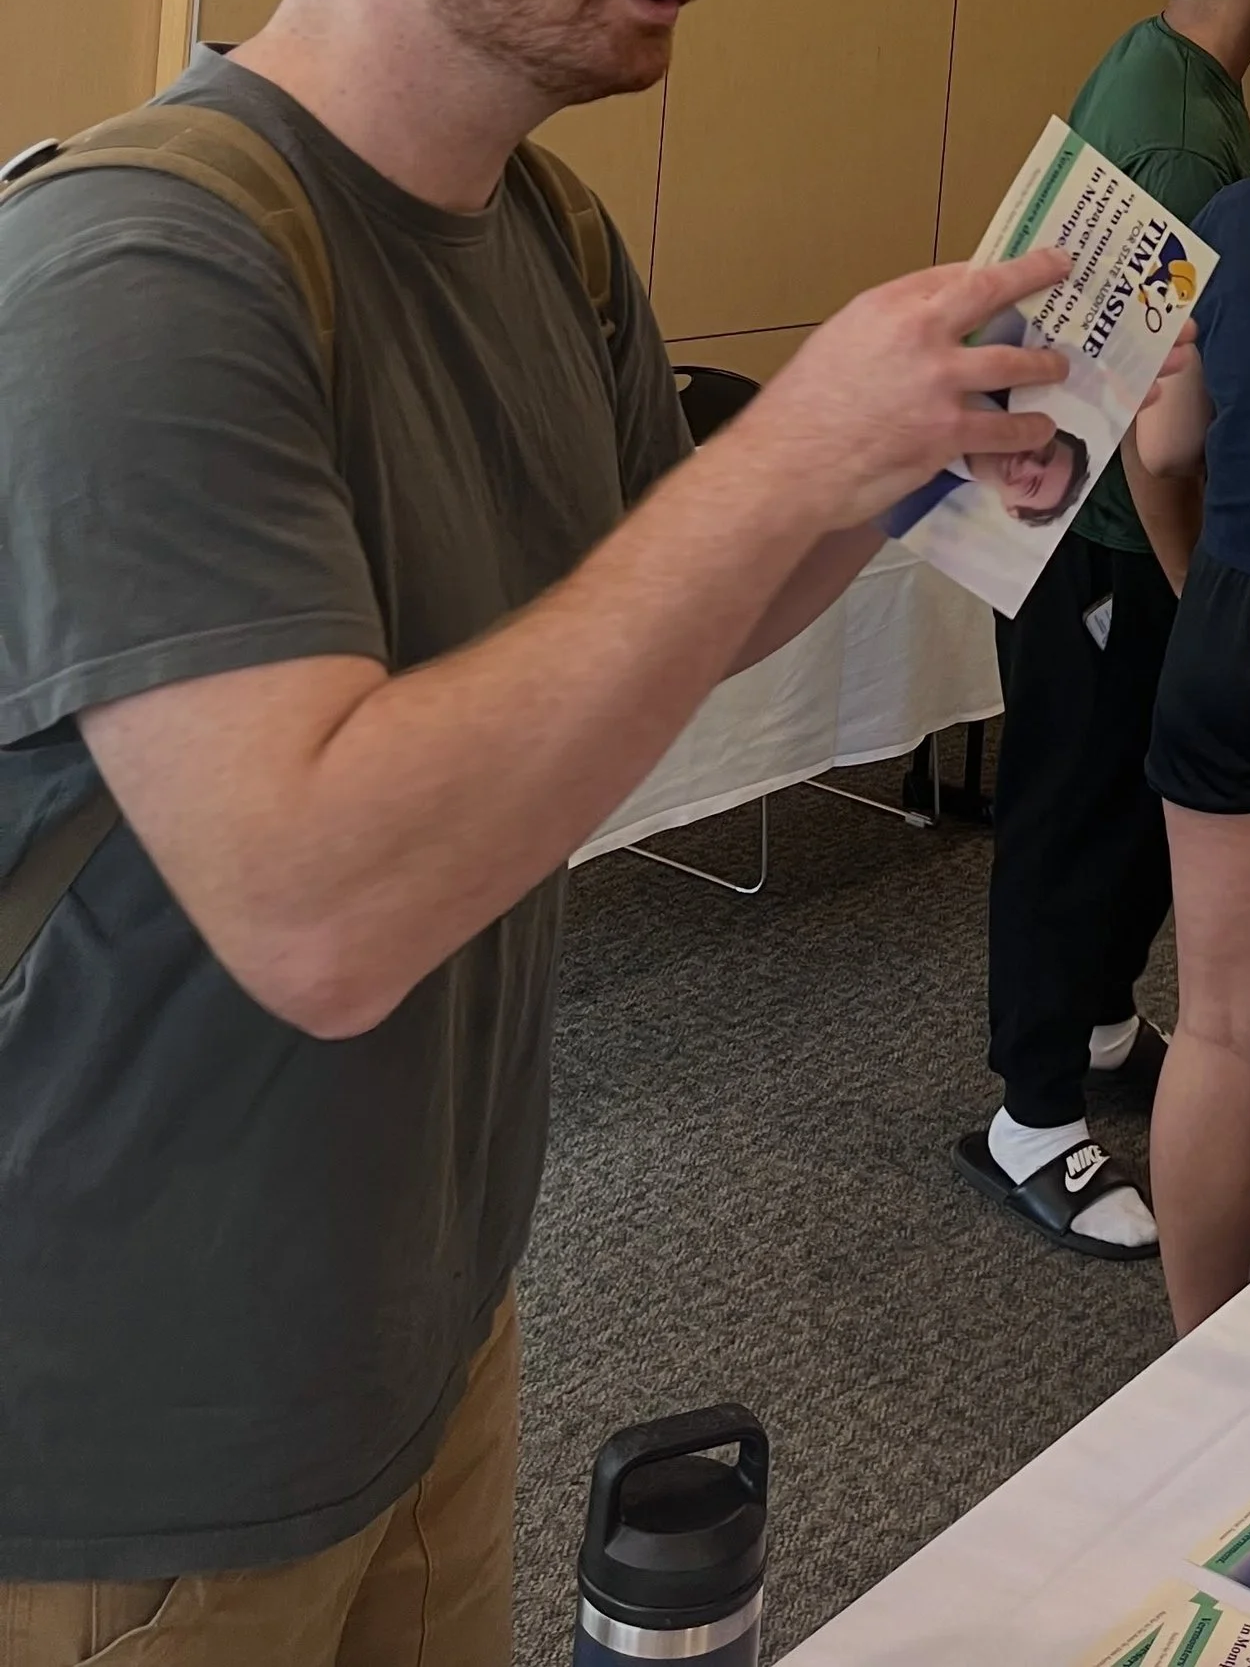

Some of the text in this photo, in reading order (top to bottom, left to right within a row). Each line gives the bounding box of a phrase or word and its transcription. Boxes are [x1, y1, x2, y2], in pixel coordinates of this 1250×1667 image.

[1090, 166, 1106, 183] in
[1078, 178, 1118, 249] taxpayer
[1072, 227, 1112, 293] running
[1080, 219, 1144, 330] FOR STATE AUDITOR
[1064, 293, 1078, 312] to
[1082, 218, 1167, 358] TIM ASHE
[1052, 312, 1070, 334] be
[1065, 1144, 1104, 1177] NIKE
